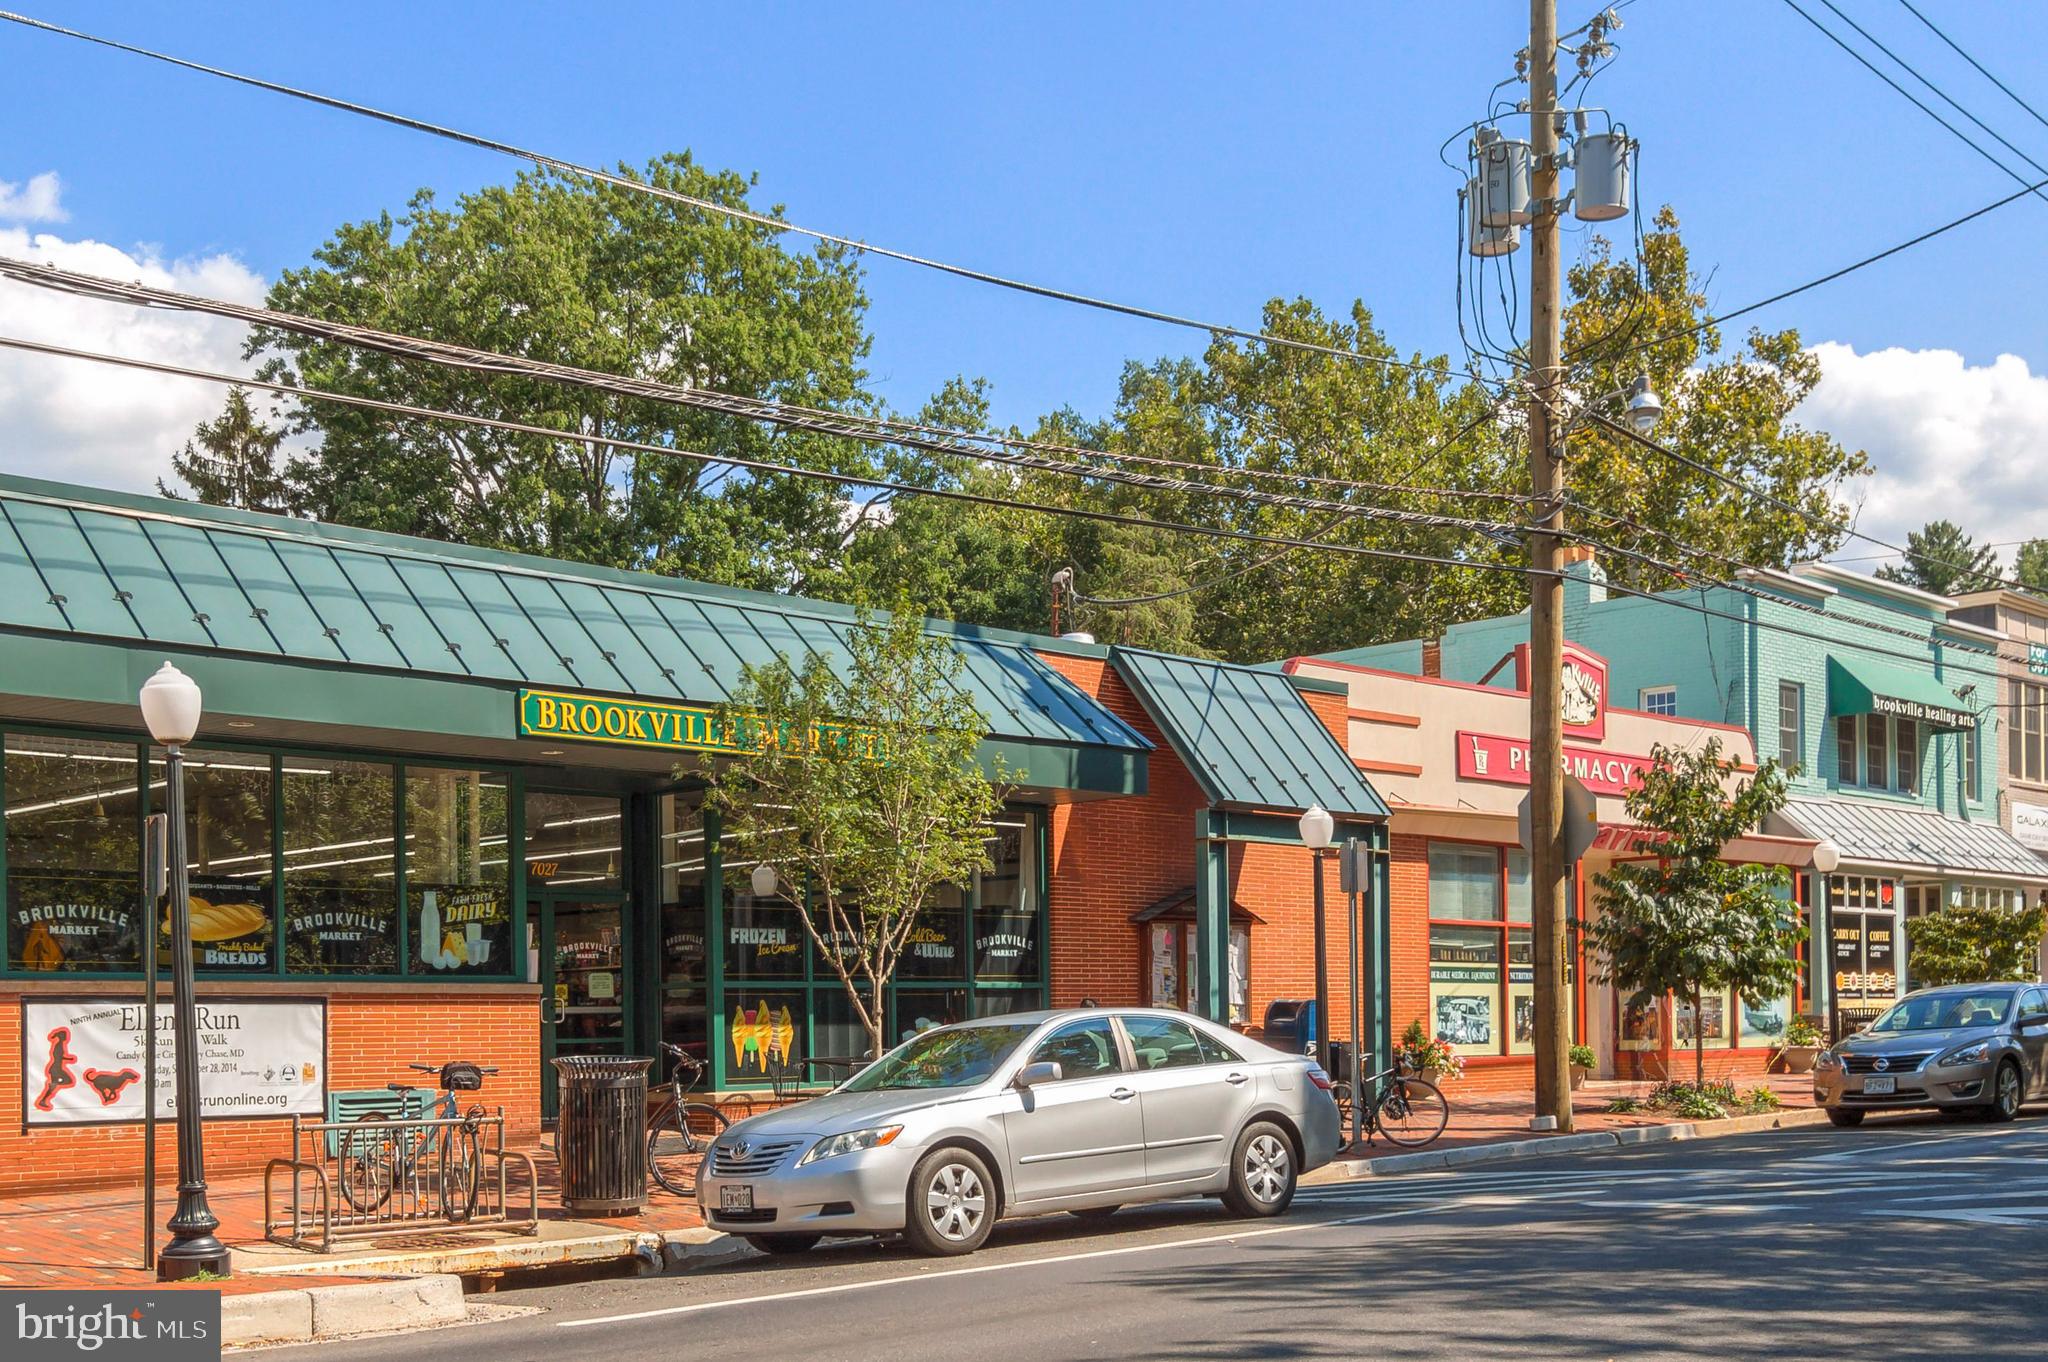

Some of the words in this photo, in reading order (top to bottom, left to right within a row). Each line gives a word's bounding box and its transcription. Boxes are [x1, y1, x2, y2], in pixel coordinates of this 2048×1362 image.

[1873, 695, 1923, 718] brookville
[1925, 705, 1957, 727] healing
[1958, 714, 1975, 727] arts
[536, 697, 737, 748] BROOKVILLE
[757, 721, 877, 760] MRKT
[1509, 747, 1632, 784] PRMACY
[531, 861, 560, 877] 7027
[18, 904, 129, 927] BROOKVILLE
[446, 901, 497, 923] DAIRY
[49, 925, 99, 935] MARKET
[293, 912, 387, 933] BROOKVILLE
[319, 931, 362, 941] MARKET
[730, 927, 786, 944] FROZEN
[904, 928, 924, 943] Cold
[975, 934, 1033, 950] BROOKVILLE
[1869, 931, 1890, 942] COFFEE
[562, 941, 613, 954] BROOKVILLE
[757, 943, 770, 956] Ice
[771, 942, 797, 954] Cream
[991, 949, 1018, 957] MARKET
[205, 949, 267, 965] BREADS
[69, 1014, 92, 1025] NINTH
[92, 1009, 121, 1020] ANNUAL
[119, 1005, 176, 1031] Ellen
[194, 1007, 241, 1031] Run
[200, 1034, 228, 1046] Walk
[116, 1051, 141, 1062] Candy
[205, 1049, 229, 1059] Chase,
[230, 1049, 245, 1058] MD
[210, 1063, 220, 1074] 28,
[221, 1062, 238, 1073] 2014
[166, 1093, 288, 1108] elsrunonline.org
